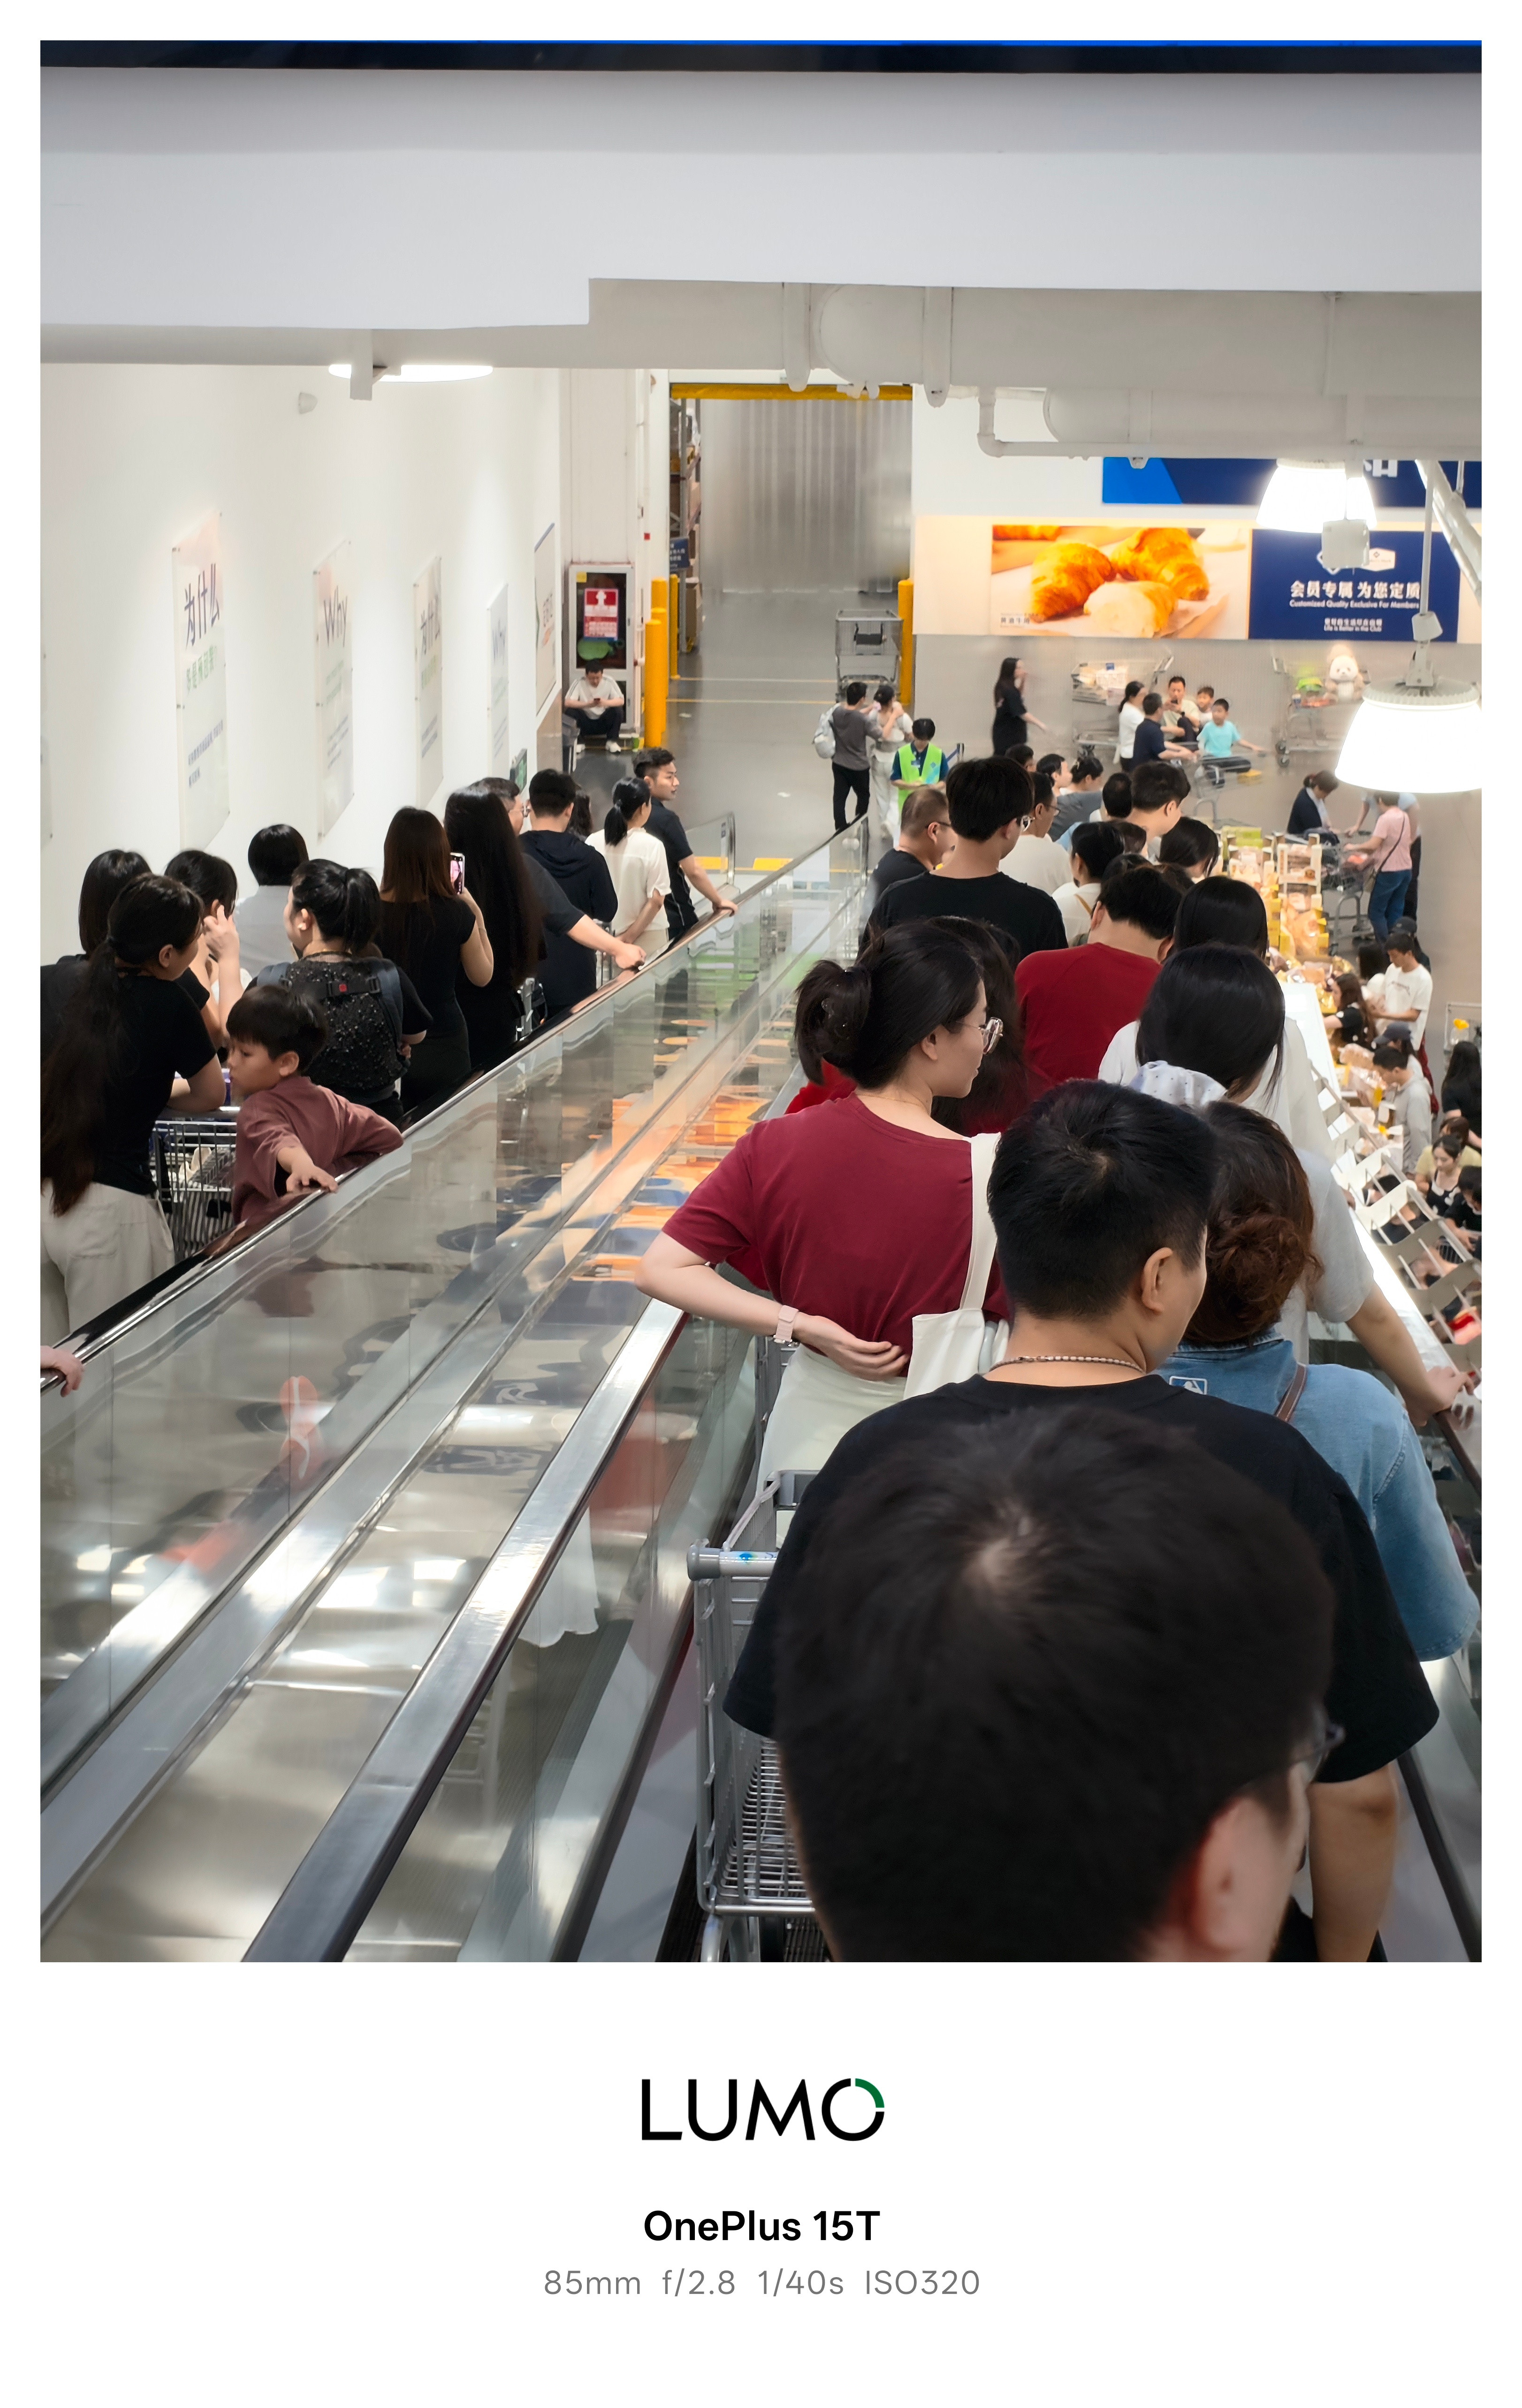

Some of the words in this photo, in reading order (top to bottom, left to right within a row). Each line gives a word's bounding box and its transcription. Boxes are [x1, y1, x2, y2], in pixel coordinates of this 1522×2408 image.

[184, 563, 220, 650] 为什么
[1289, 599, 1325, 608] Customized
[1326, 600, 1349, 609] Quality
[1290, 580, 1353, 598] 会员专属
[1357, 581, 1420, 600] 为您定质
[323, 585, 348, 648] Why
